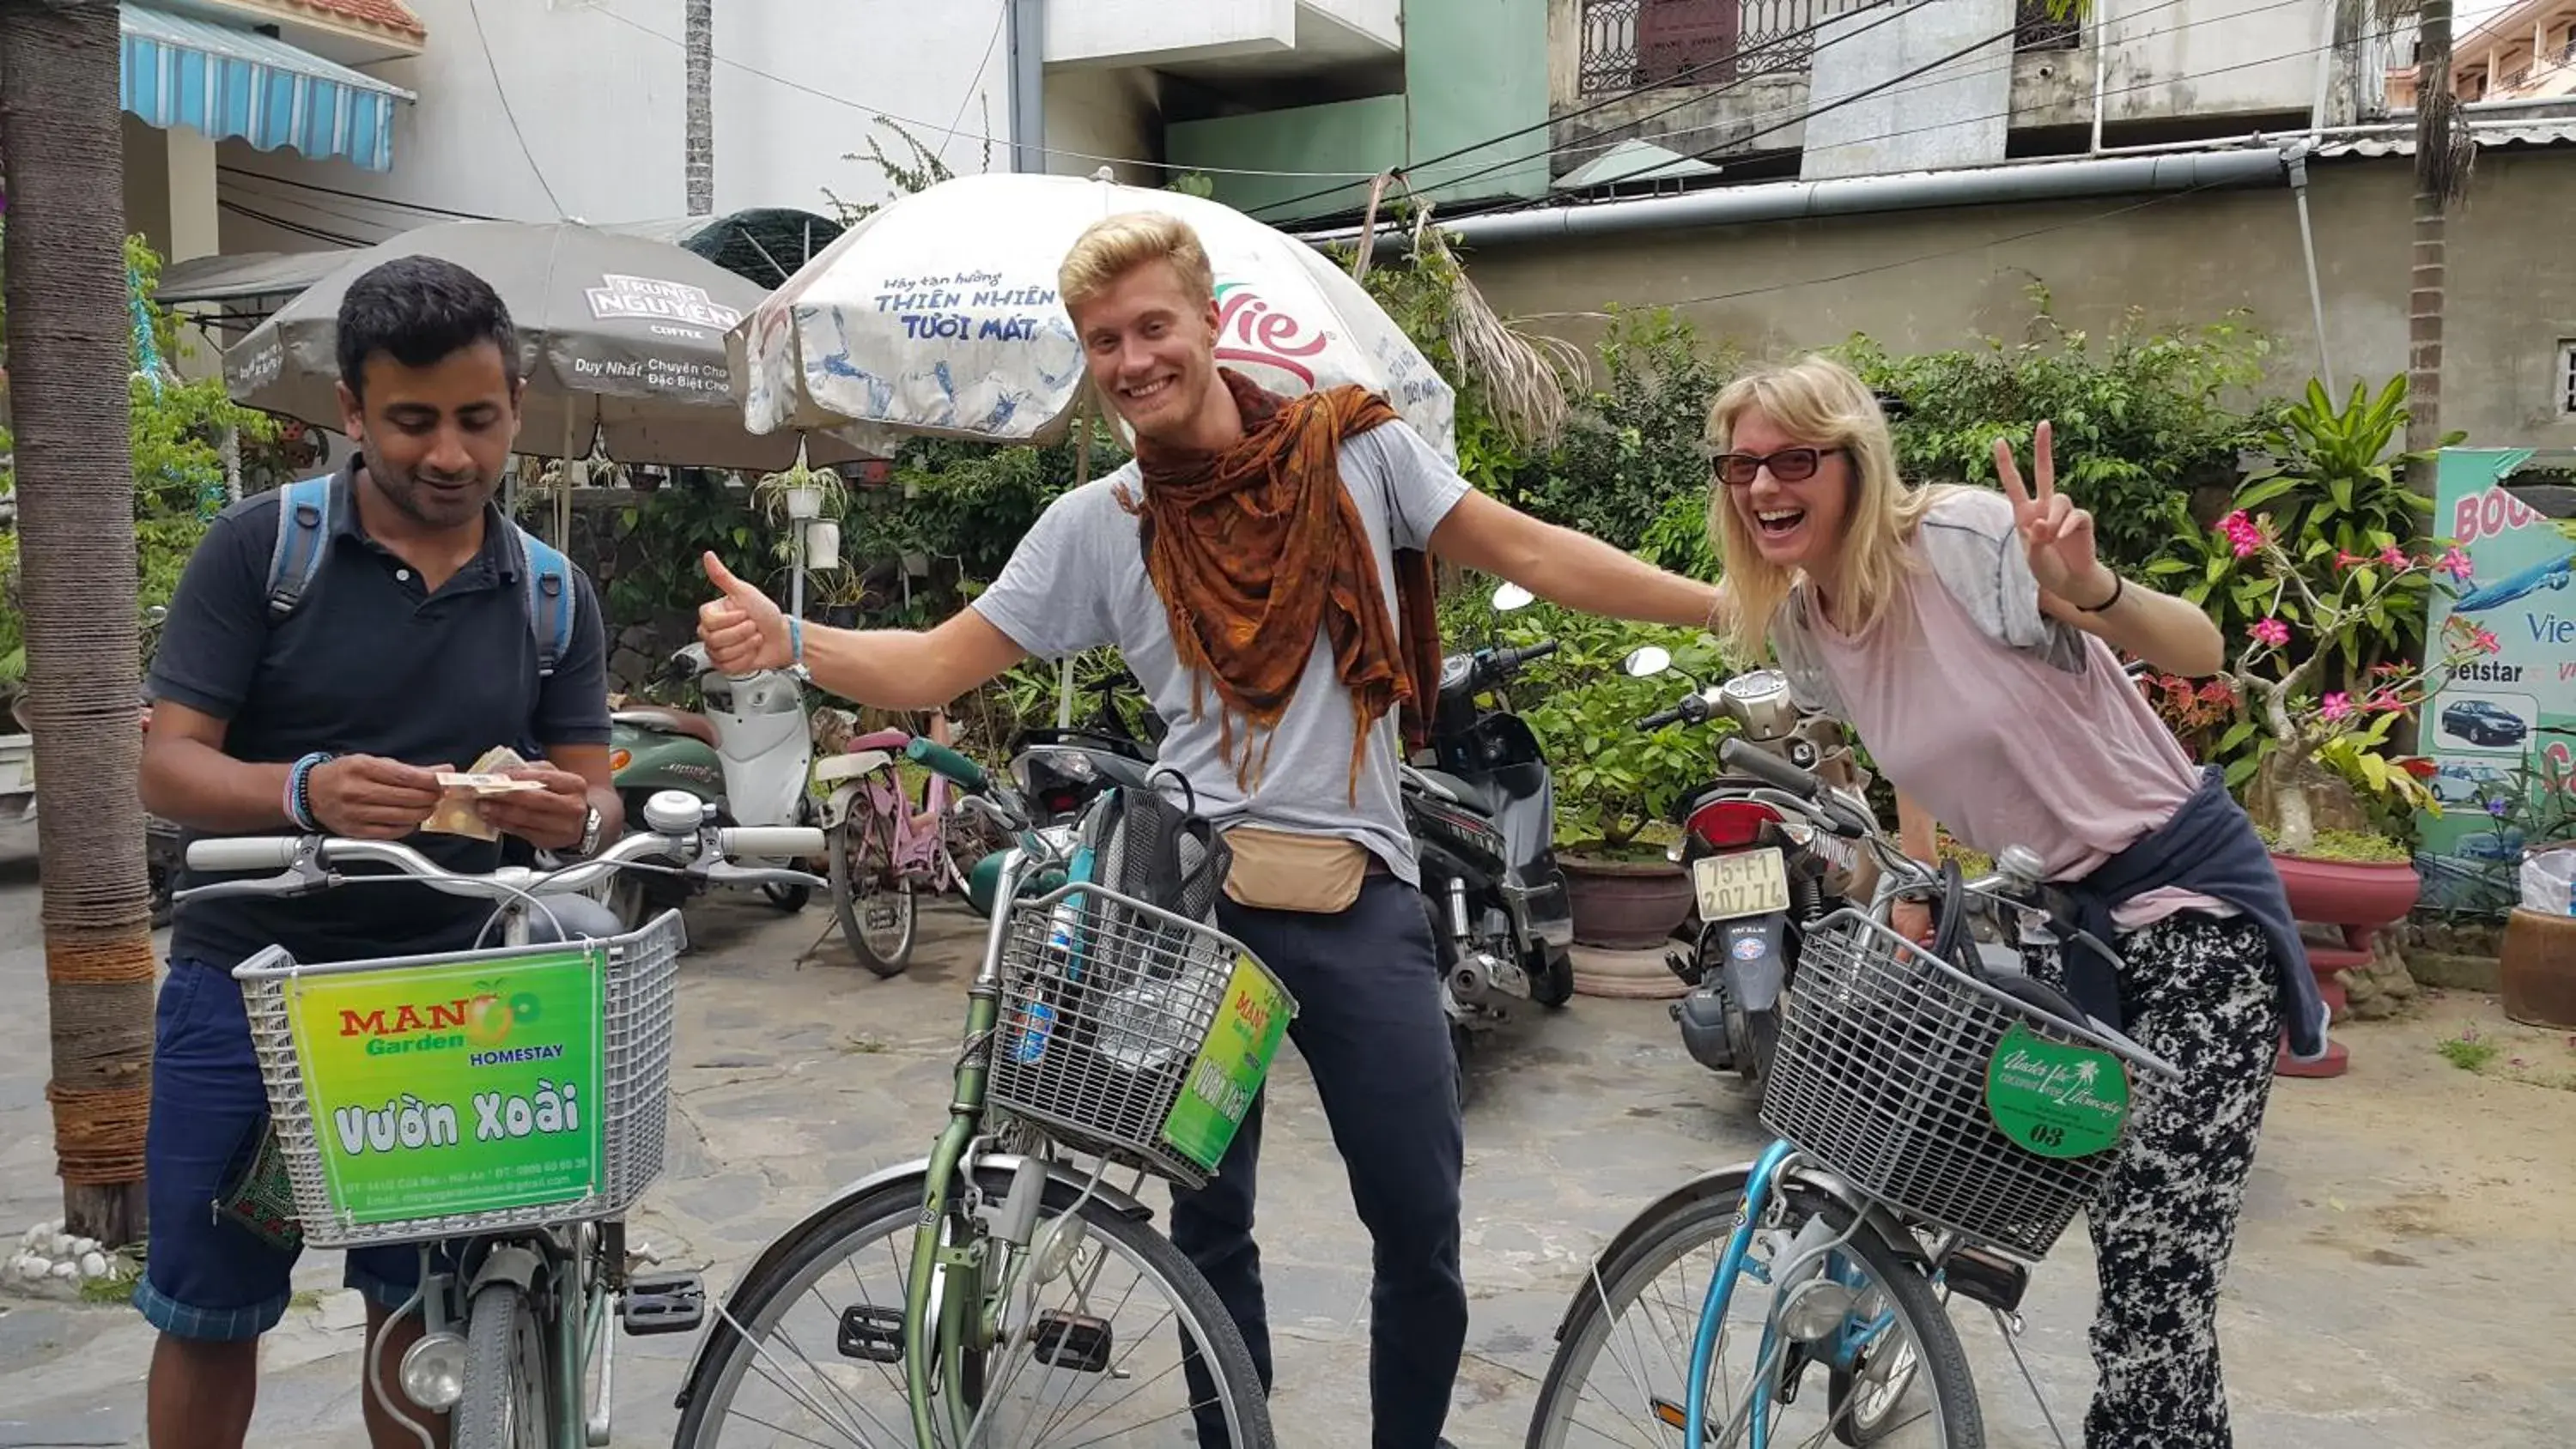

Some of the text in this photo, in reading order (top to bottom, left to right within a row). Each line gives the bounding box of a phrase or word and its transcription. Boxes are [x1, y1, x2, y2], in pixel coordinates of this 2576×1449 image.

[615, 279, 697, 301] TRUNG
[874, 286, 1055, 312] THIÊN NHIÊN
[979, 313, 1038, 342] MÁT
[575, 358, 643, 377] Duy Nhất
[648, 358, 727, 378] Chuyên Cho
[677, 375, 702, 391] Biệt
[705, 379, 729, 392] Cho
[2455, 487, 2548, 547] BOO
[366, 1034, 464, 1057] Garden
[470, 1044, 563, 1066] HOMESTAY
[334, 1078, 579, 1155] Vườn Xoài
[2029, 1123, 2065, 1148] 03
